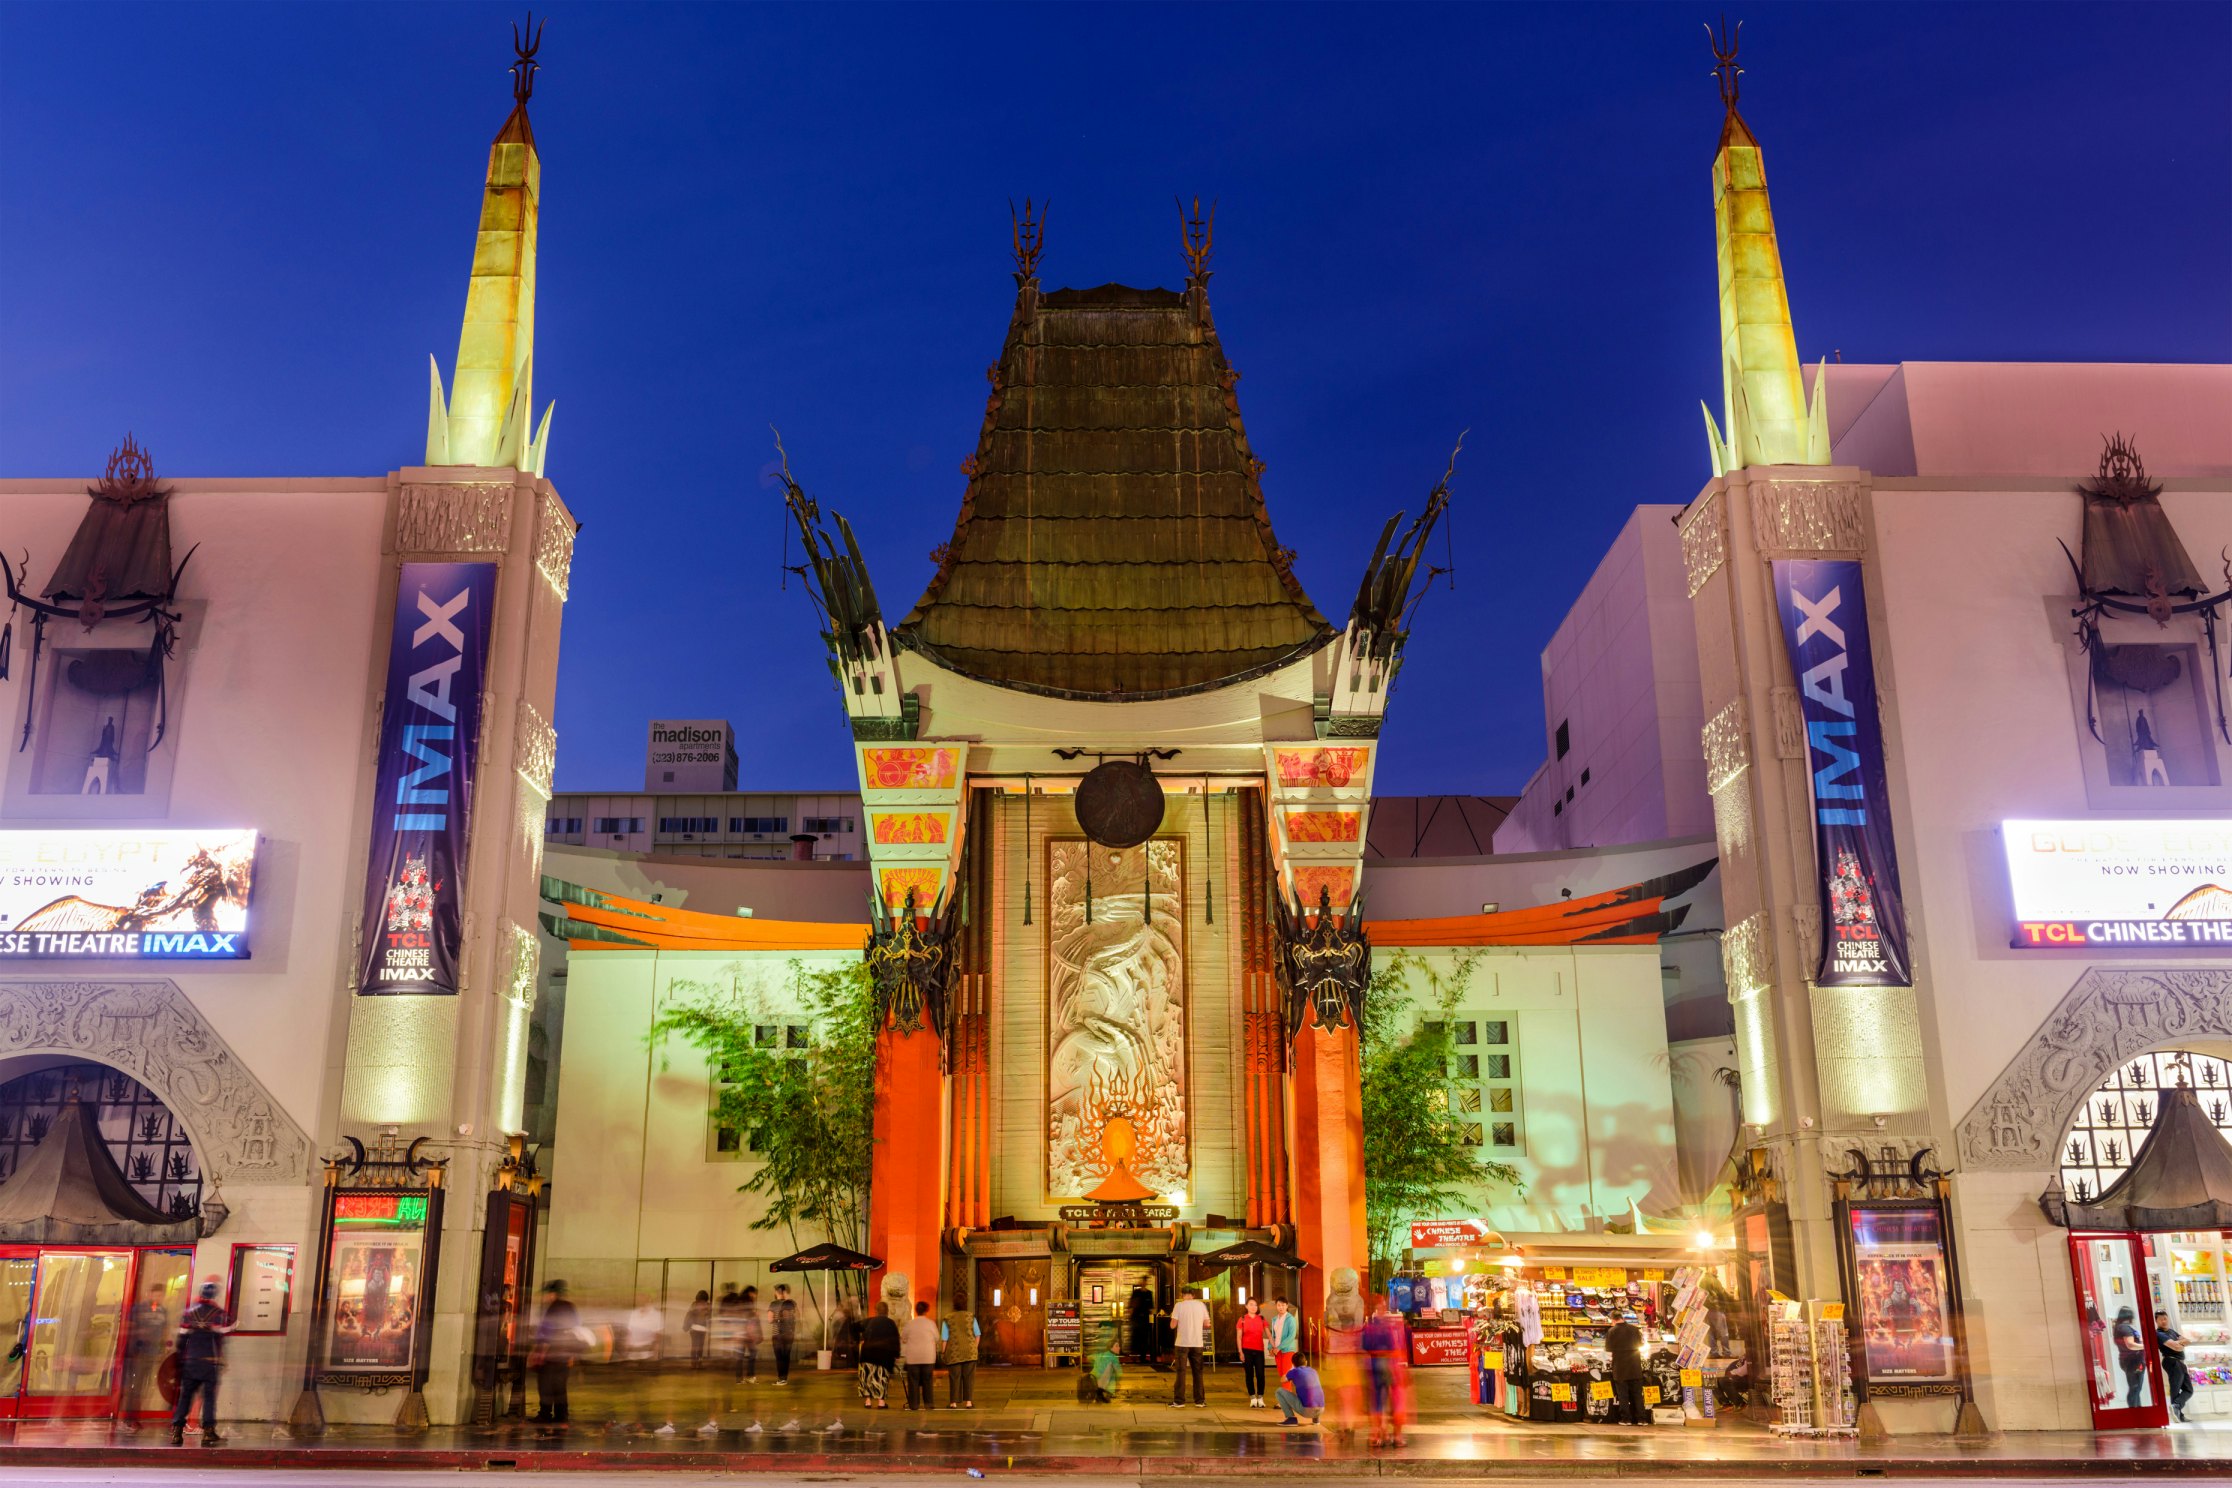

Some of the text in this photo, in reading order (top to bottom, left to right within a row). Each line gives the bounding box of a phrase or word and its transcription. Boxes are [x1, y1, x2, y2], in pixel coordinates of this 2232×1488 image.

[394, 586, 470, 831] IMAX
[1791, 585, 1867, 826] IMAX
[652, 726, 722, 742] madison
[679, 743, 721, 751] apartments
[676, 752, 720, 763] 876-2006
[2102, 865, 2226, 875] NOW SHOWING
[13, 875, 94, 886] SHOWING
[1835, 925, 1879, 940] TCL
[2024, 922, 2085, 942] TCL
[2087, 922, 2186, 942] CHINESE
[35, 933, 139, 953] THEATRE
[143, 933, 237, 953] IMAX
[387, 933, 431, 948] TCL
[1836, 941, 1880, 950] CHINESE
[386, 949, 430, 958] CHINESE
[1837, 949, 1881, 958] THEATRE
[385, 957, 430, 966] THEATRE
[1833, 960, 1888, 973] IMAX
[380, 968, 437, 981] IMAX
[1066, 1209, 1089, 1217] TCL
[1427, 1227, 1461, 1235] CHINESE
[1439, 1234, 1475, 1242] THEATRE
